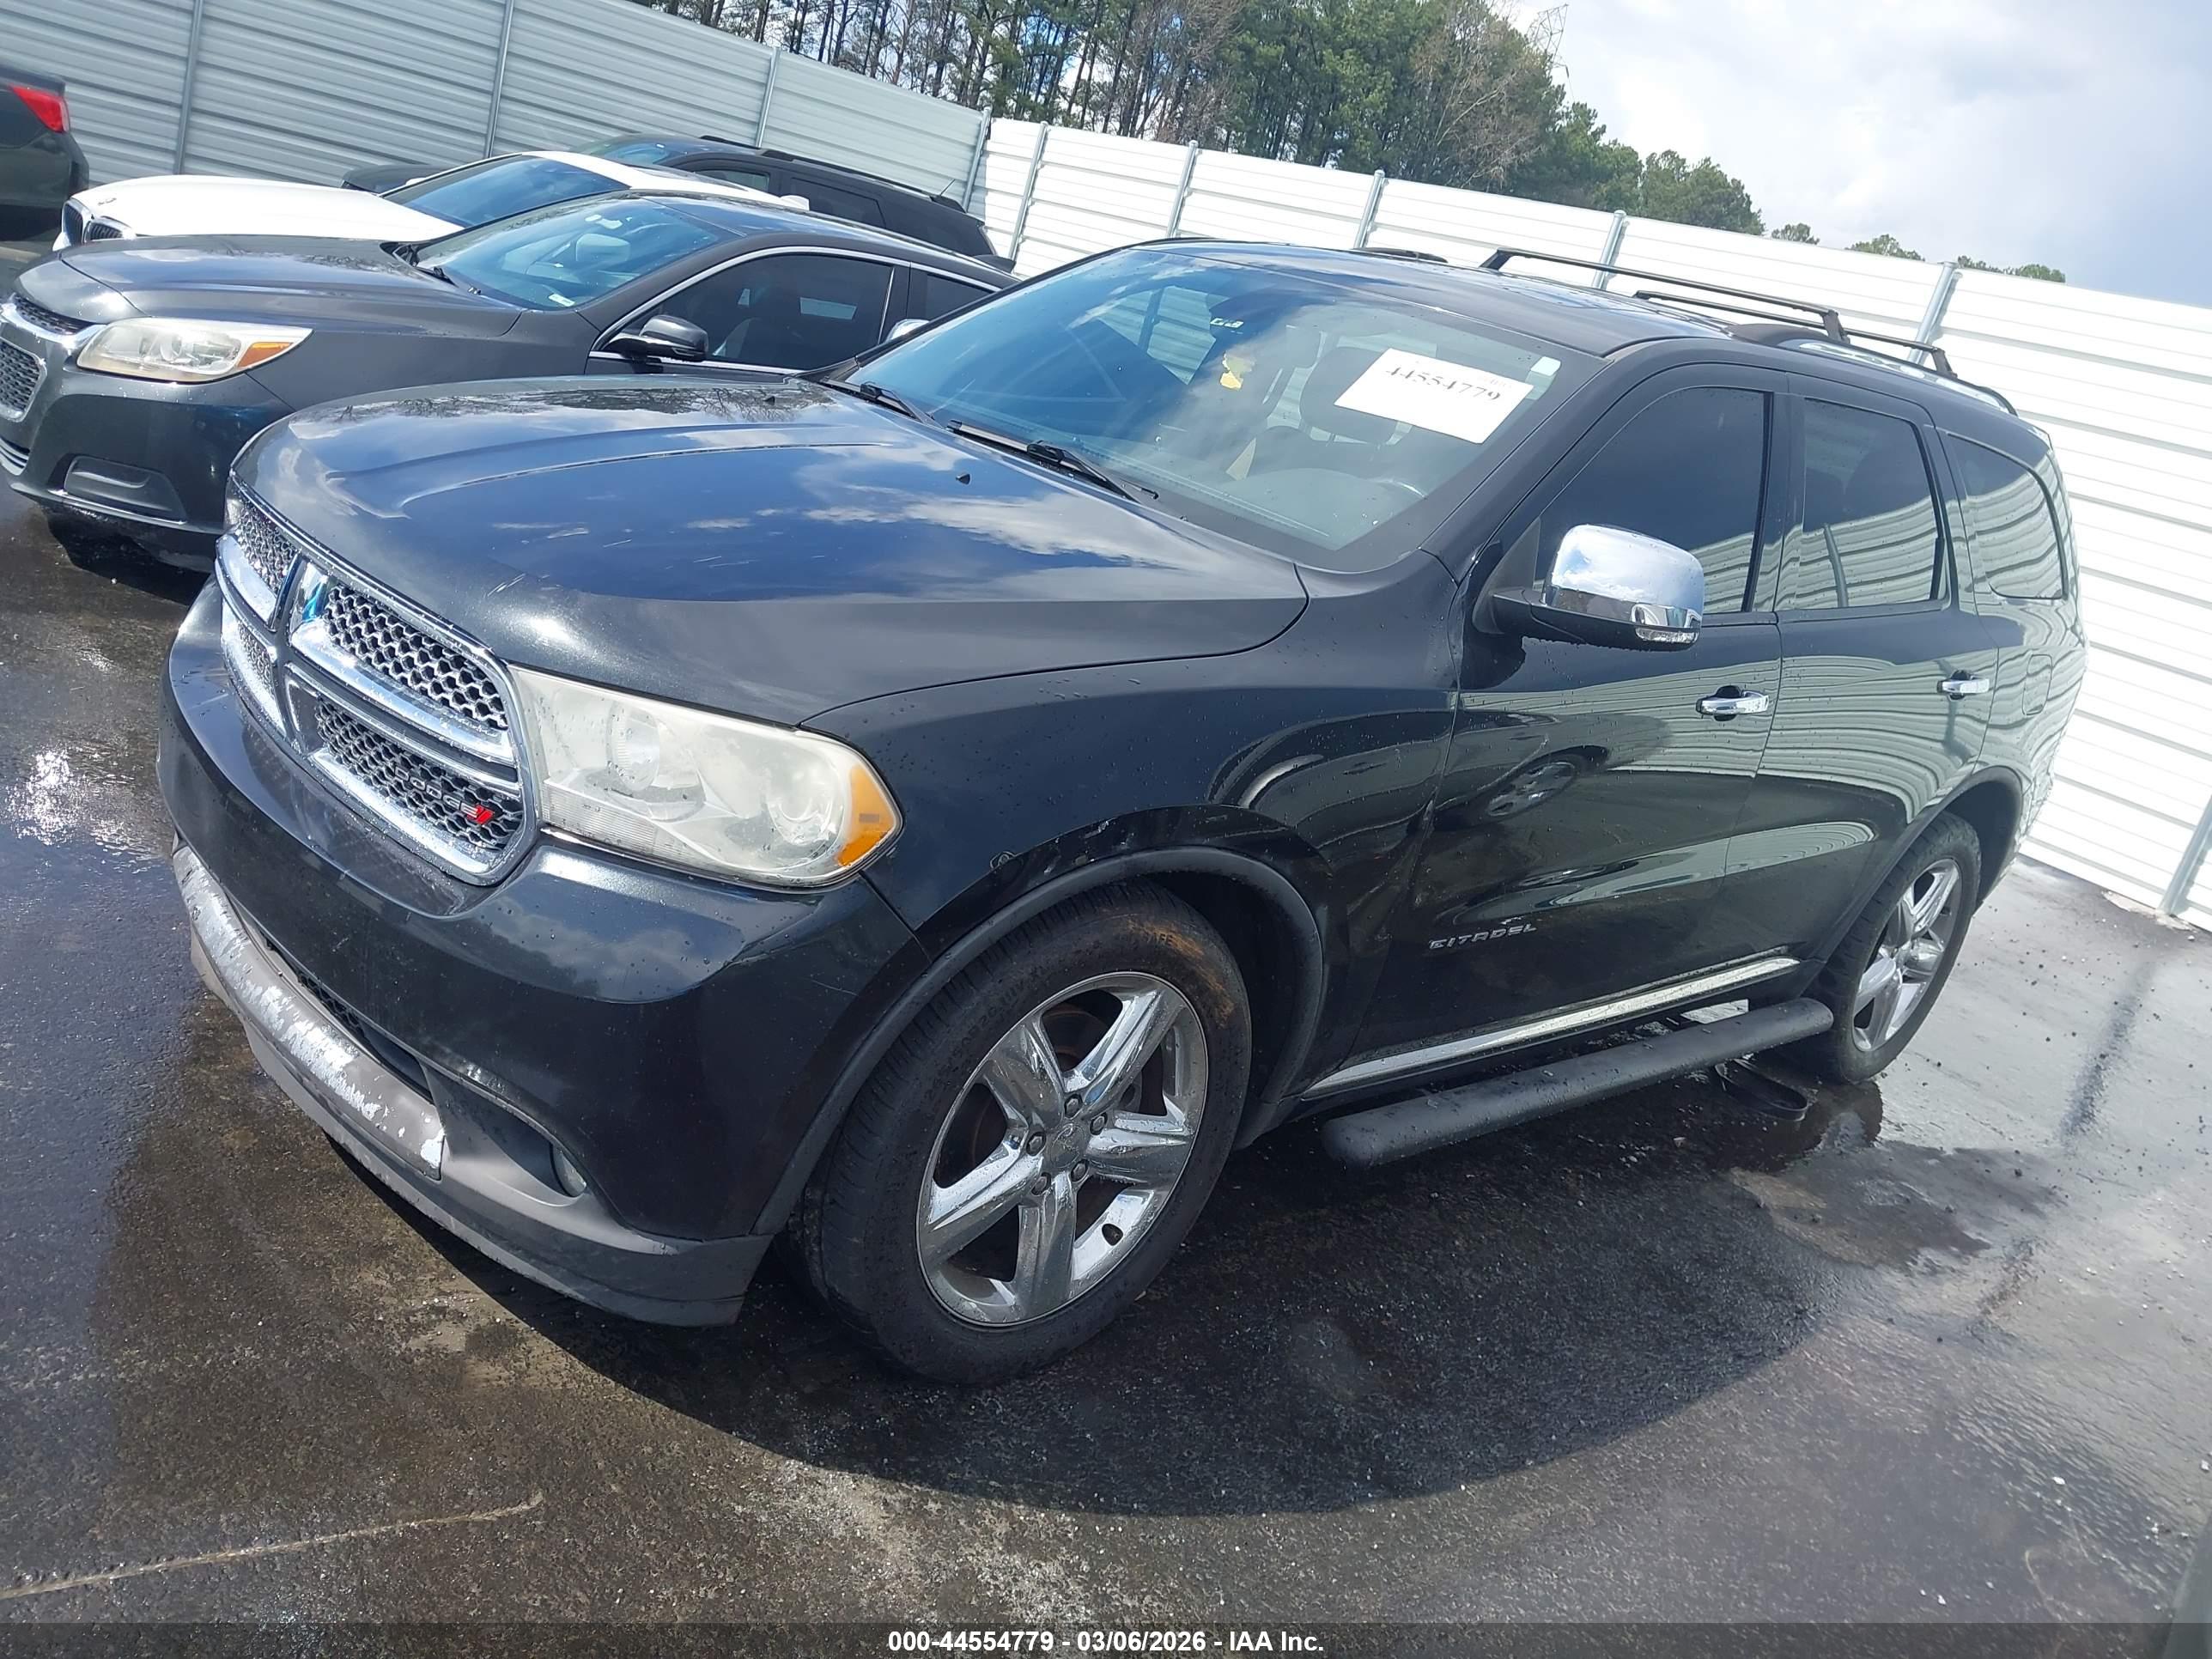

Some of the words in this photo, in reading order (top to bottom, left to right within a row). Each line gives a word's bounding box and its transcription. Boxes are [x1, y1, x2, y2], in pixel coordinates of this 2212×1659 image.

[1385, 365, 1501, 400] 44554779
[394, 766, 479, 819] DODGE
[1430, 923, 1537, 949] CITADEL
